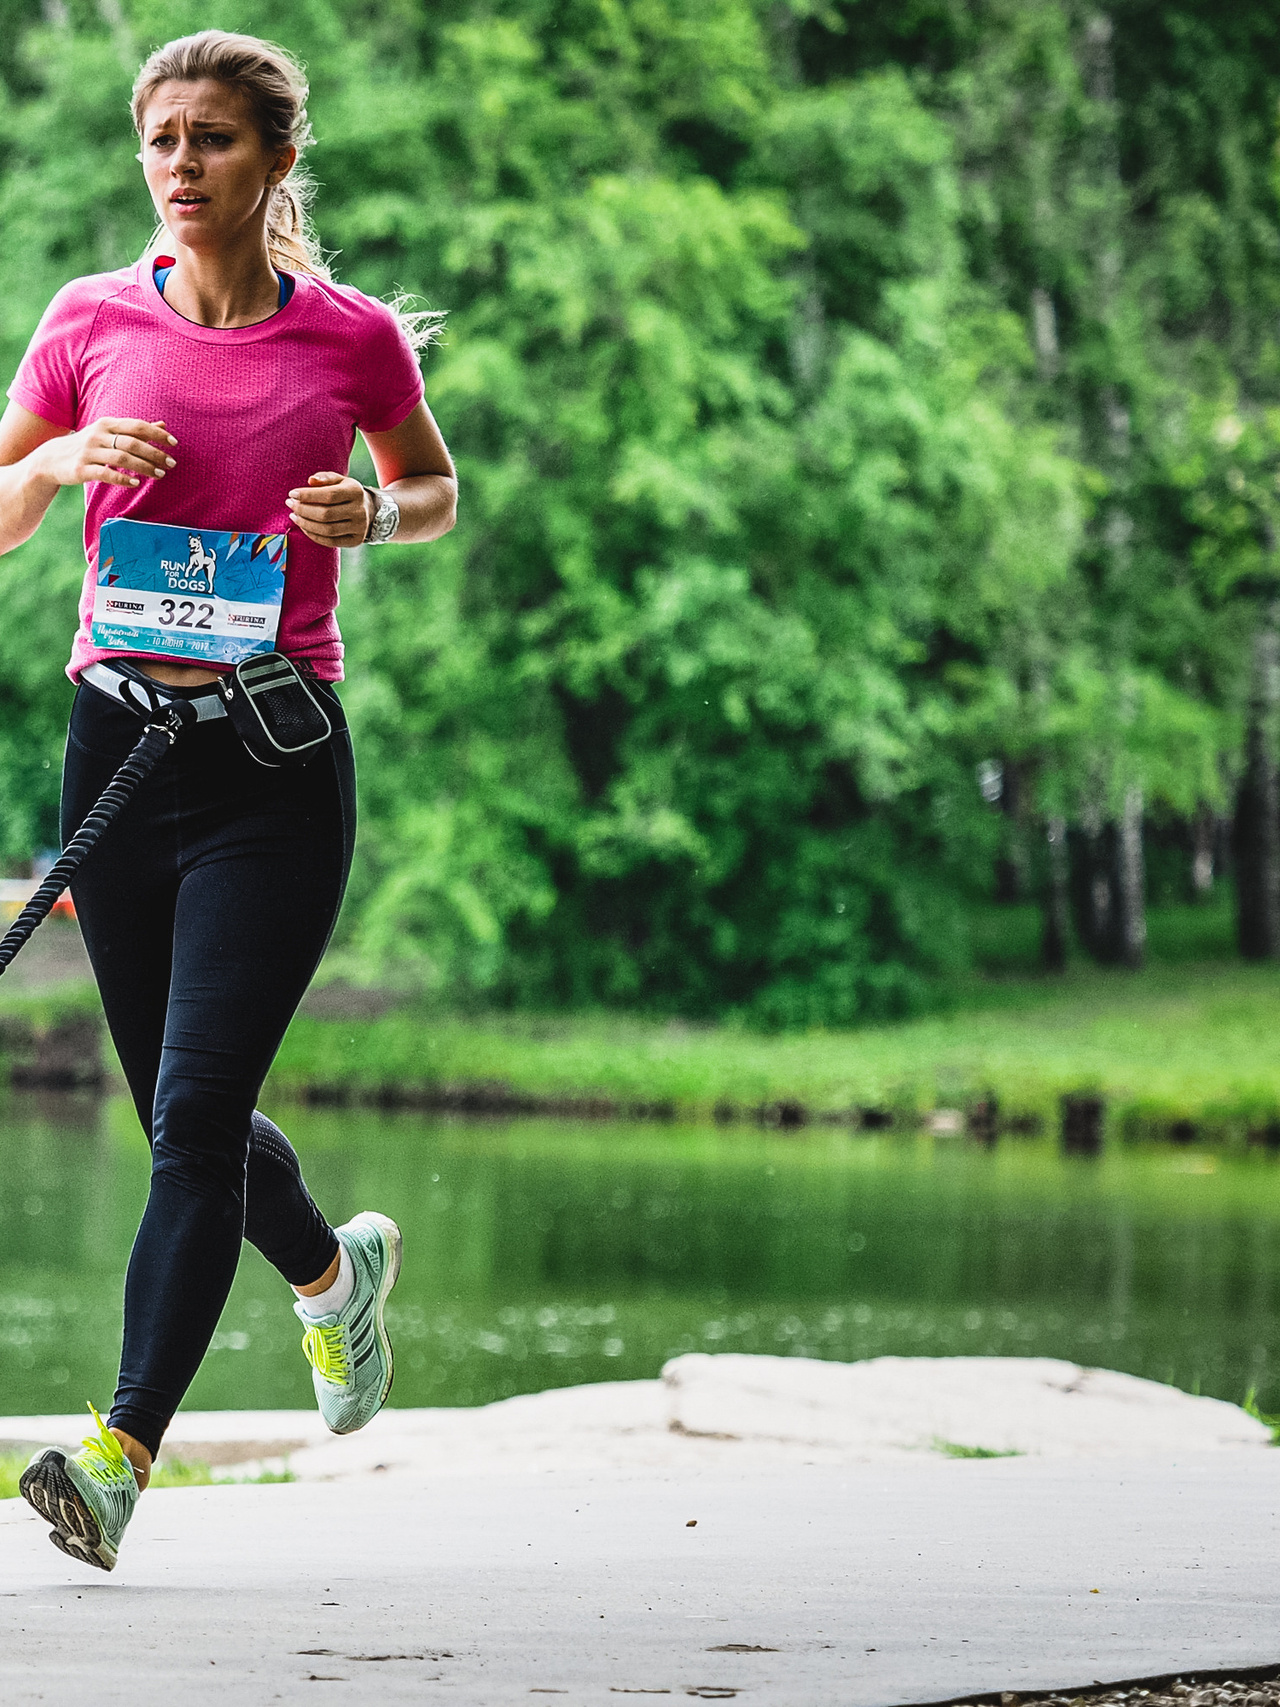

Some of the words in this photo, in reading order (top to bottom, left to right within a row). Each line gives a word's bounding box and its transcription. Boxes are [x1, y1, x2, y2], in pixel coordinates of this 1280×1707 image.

[160, 560, 186, 571] RUN
[168, 577, 206, 592] DOGS
[114, 601, 143, 610] PURINA
[158, 598, 215, 629] 322
[235, 615, 264, 624] PURINA
[152, 637, 161, 645] 10
[161, 638, 185, 649] ИЮНЯ
[190, 641, 210, 651] 2017
